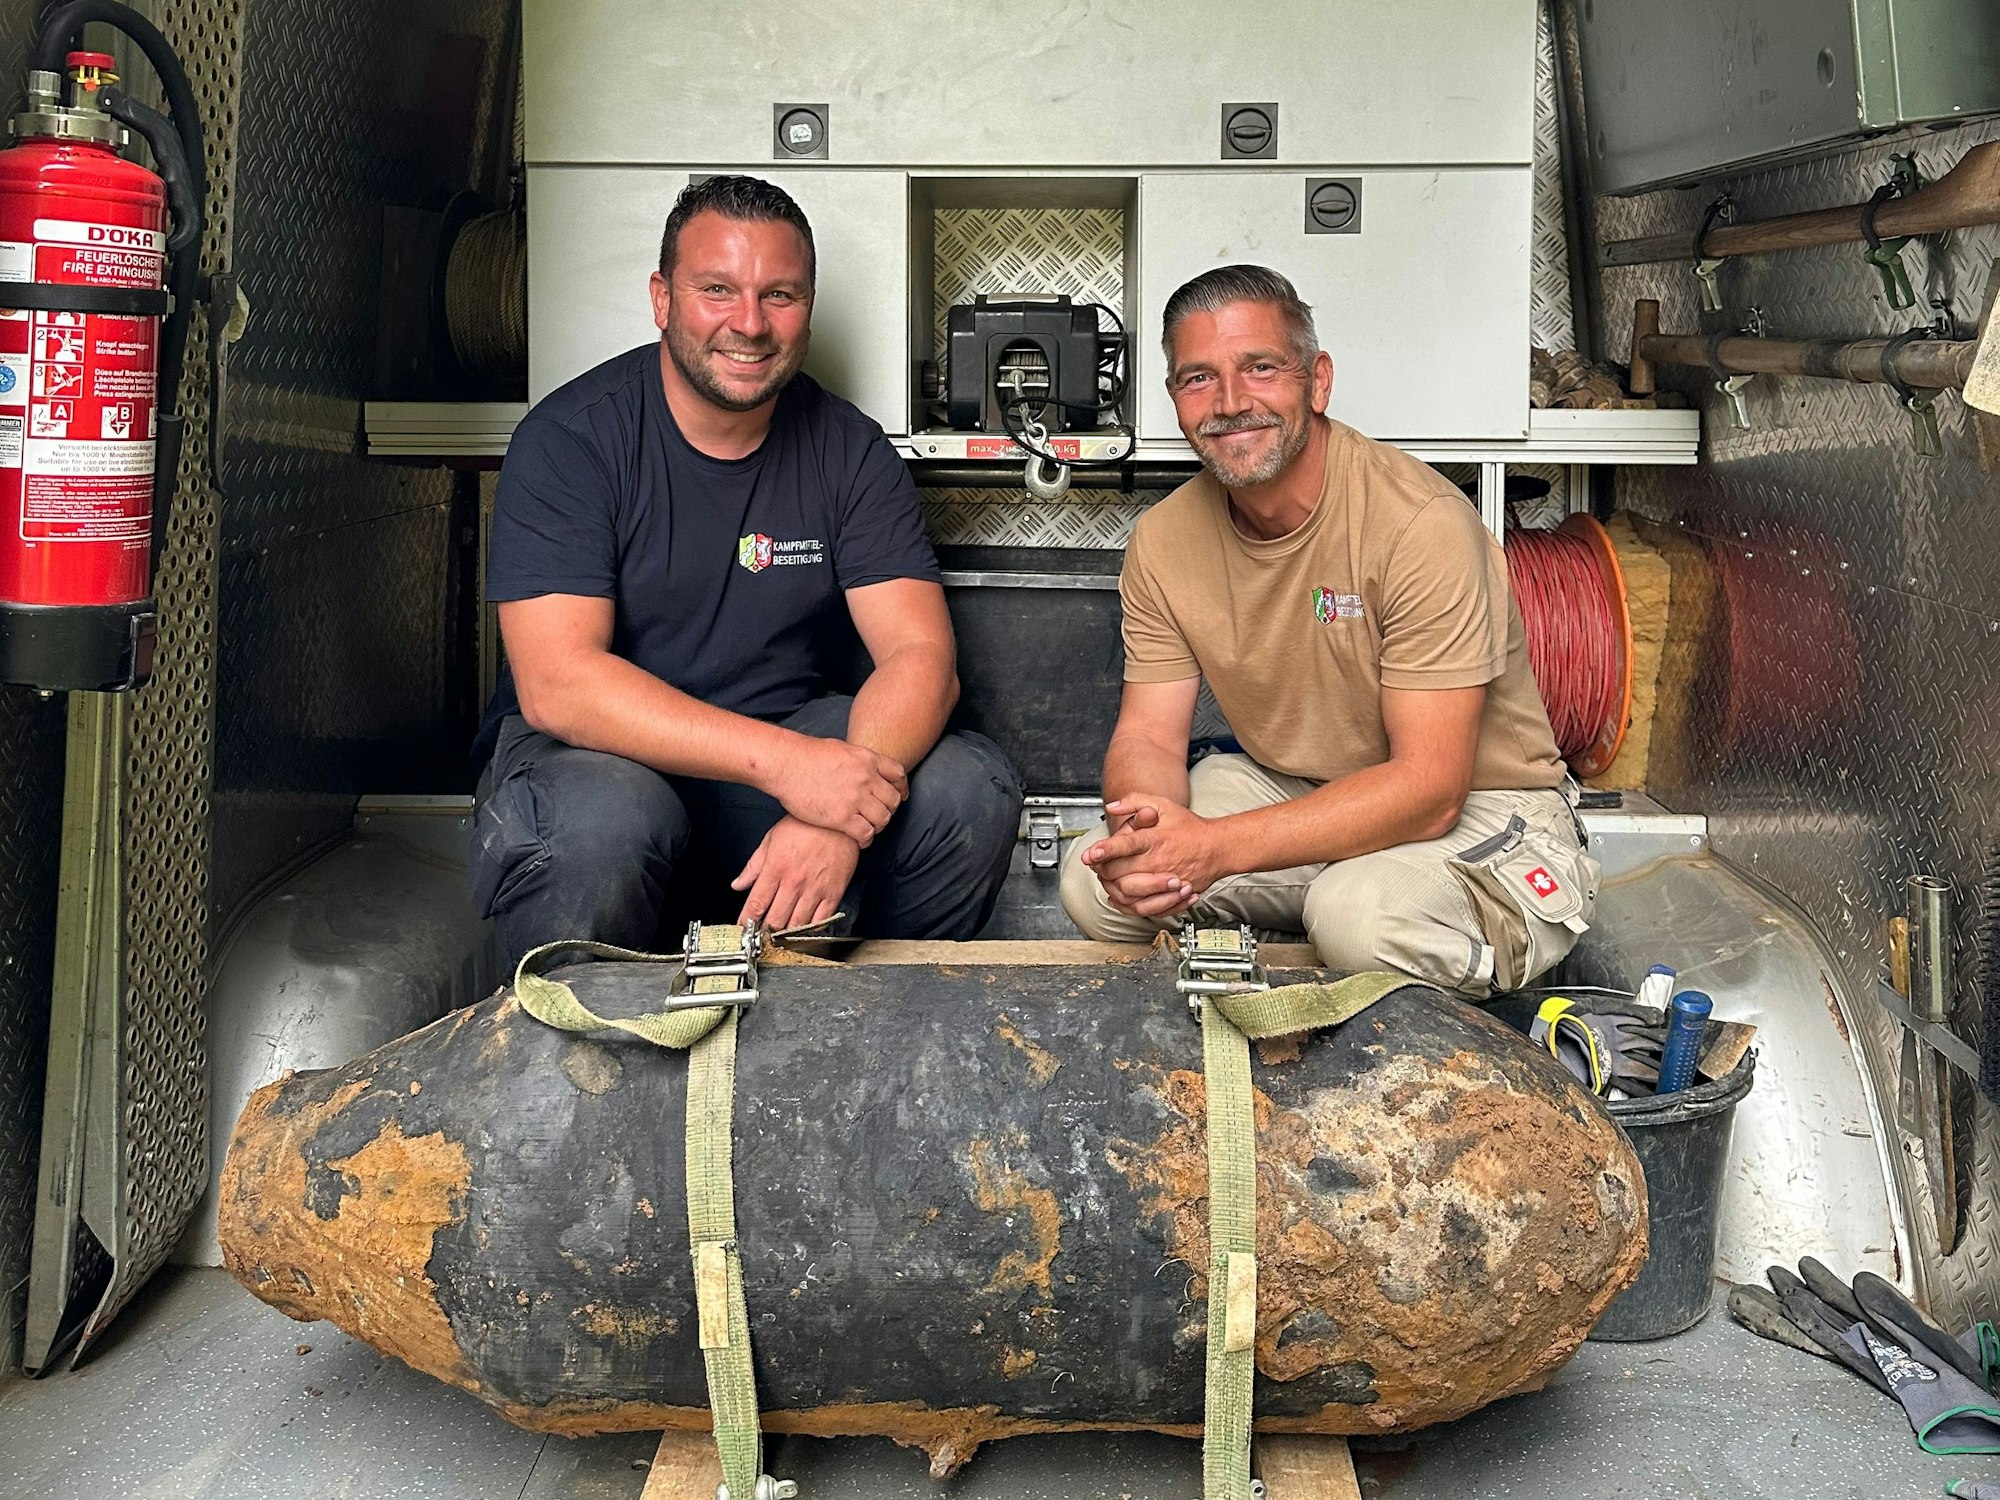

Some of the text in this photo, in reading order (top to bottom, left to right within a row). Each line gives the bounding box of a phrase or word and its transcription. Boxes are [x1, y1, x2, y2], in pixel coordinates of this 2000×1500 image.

[62, 261, 162, 281] FIRE EXTINGUISHE
[37, 330, 45, 341] 2
[35, 365, 44, 377] 3
[55, 404, 130, 420] A B
[1063, 444, 1077, 455] kg
